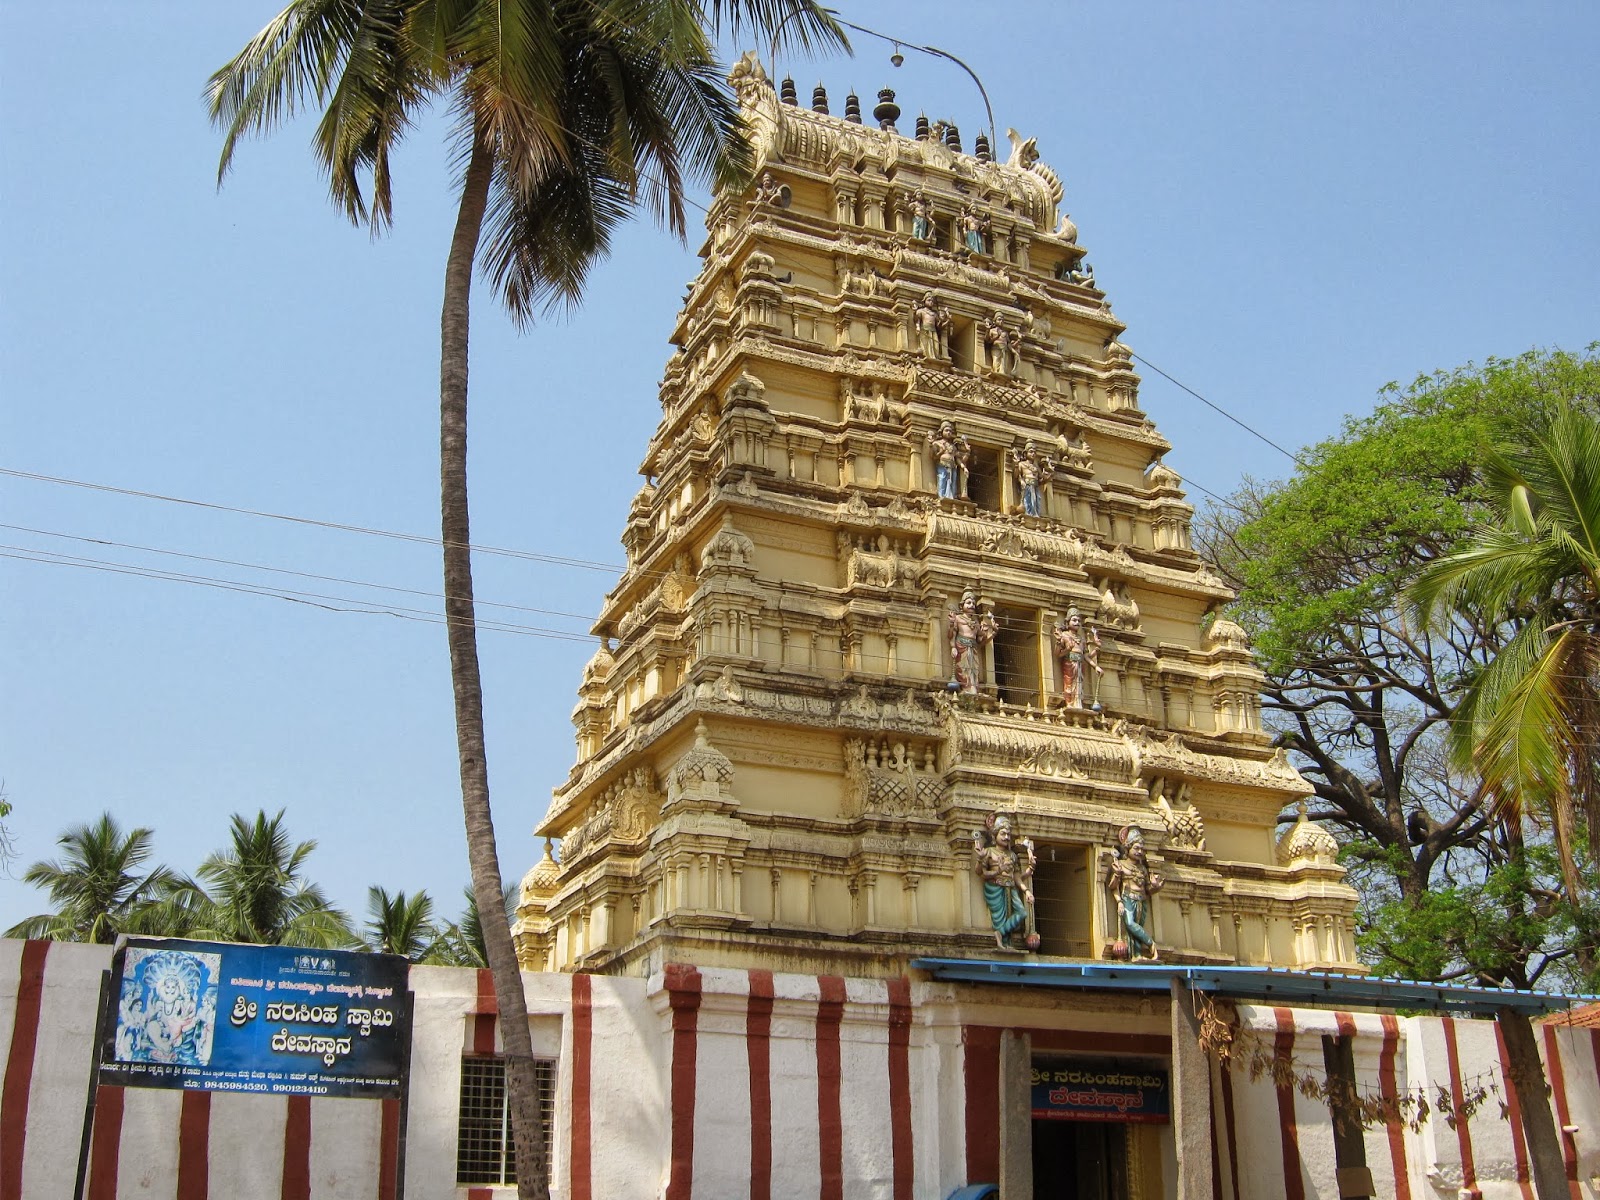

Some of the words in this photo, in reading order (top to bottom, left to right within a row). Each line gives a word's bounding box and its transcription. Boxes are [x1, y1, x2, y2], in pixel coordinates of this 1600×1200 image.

[265, 979, 276, 991] ಶ್ರೀ
[230, 995, 257, 1025] ಶ್ರೀ
[266, 1000, 339, 1024] ನರಸಿಂಹ
[346, 1007, 393, 1036] ಸ್ವಾಮಿ
[271, 1027, 352, 1066] ದೇವಸ್ಥಾನ
[272, 1084, 327, 1094] 9901234110
[1049, 1086, 1144, 1112] ದೇವಸ್ಥಾನ
